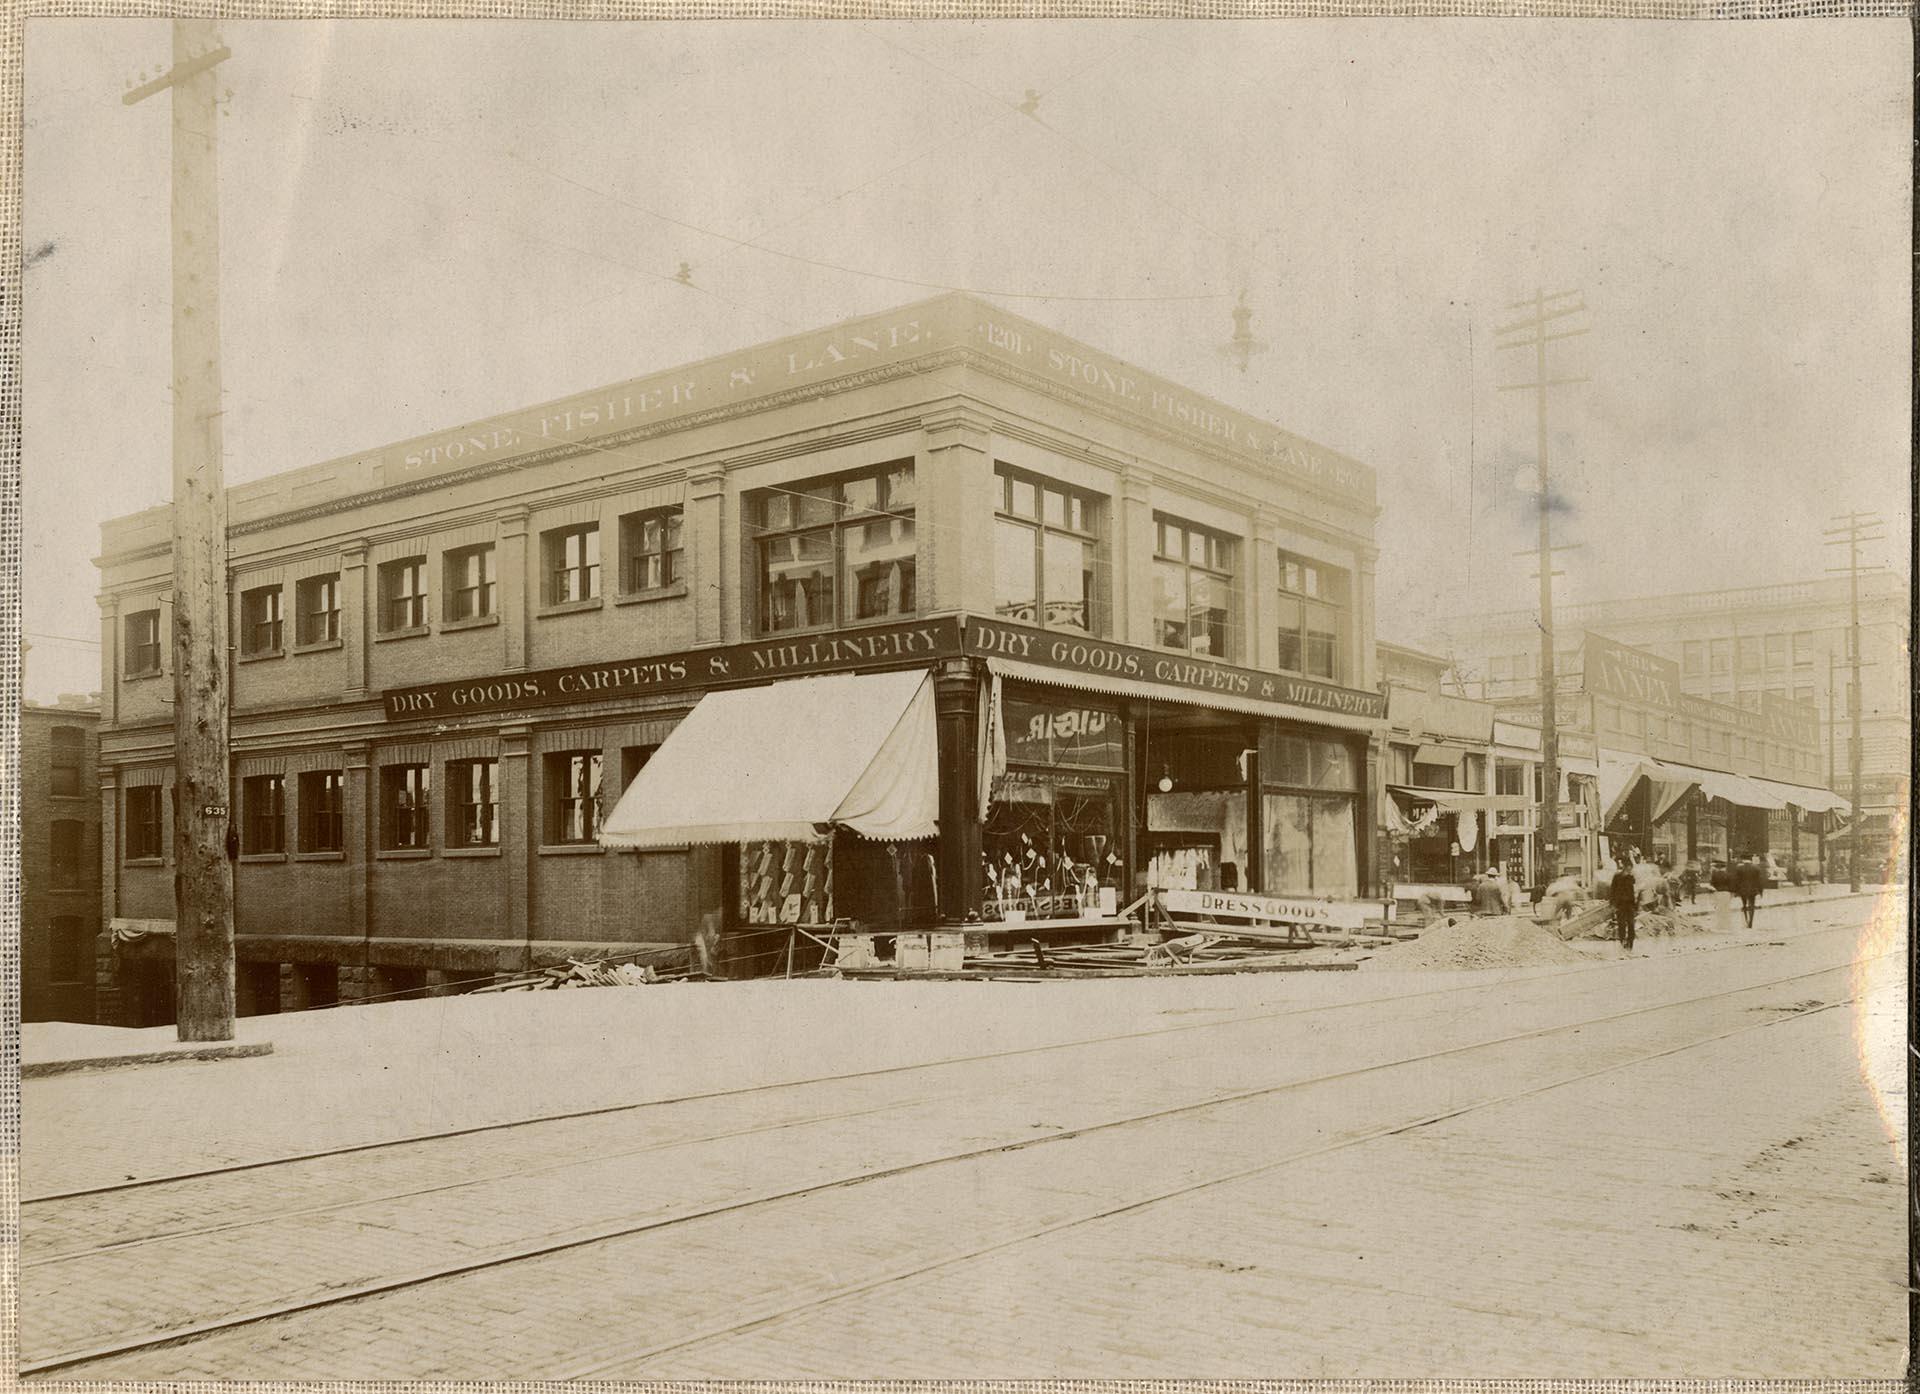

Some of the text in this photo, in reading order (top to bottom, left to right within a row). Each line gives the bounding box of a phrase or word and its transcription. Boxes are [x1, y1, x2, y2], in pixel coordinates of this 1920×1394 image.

[404, 428, 520, 471] STONE,
[540, 382, 696, 438] FISHER
[729, 367, 756, 389] &
[1049, 349, 1141, 401] STONE,
[1152, 391, 1237, 441] FISHER
[1247, 430, 1261, 450] &
[391, 691, 438, 713] DRY
[558, 660, 687, 693] CARPETS
[709, 656, 729, 675] &
[752, 628, 940, 670] MILLINERY
[976, 627, 1036, 656] DRY
[1051, 641, 1144, 677] GOODS,
[1155, 660, 1250, 692] CARPETS
[1260, 679, 1275, 697] &
[1594, 658, 1673, 707] ANNEX
[205, 806, 227, 816] 635
[1202, 894, 1329, 919] DRESS GOODS
